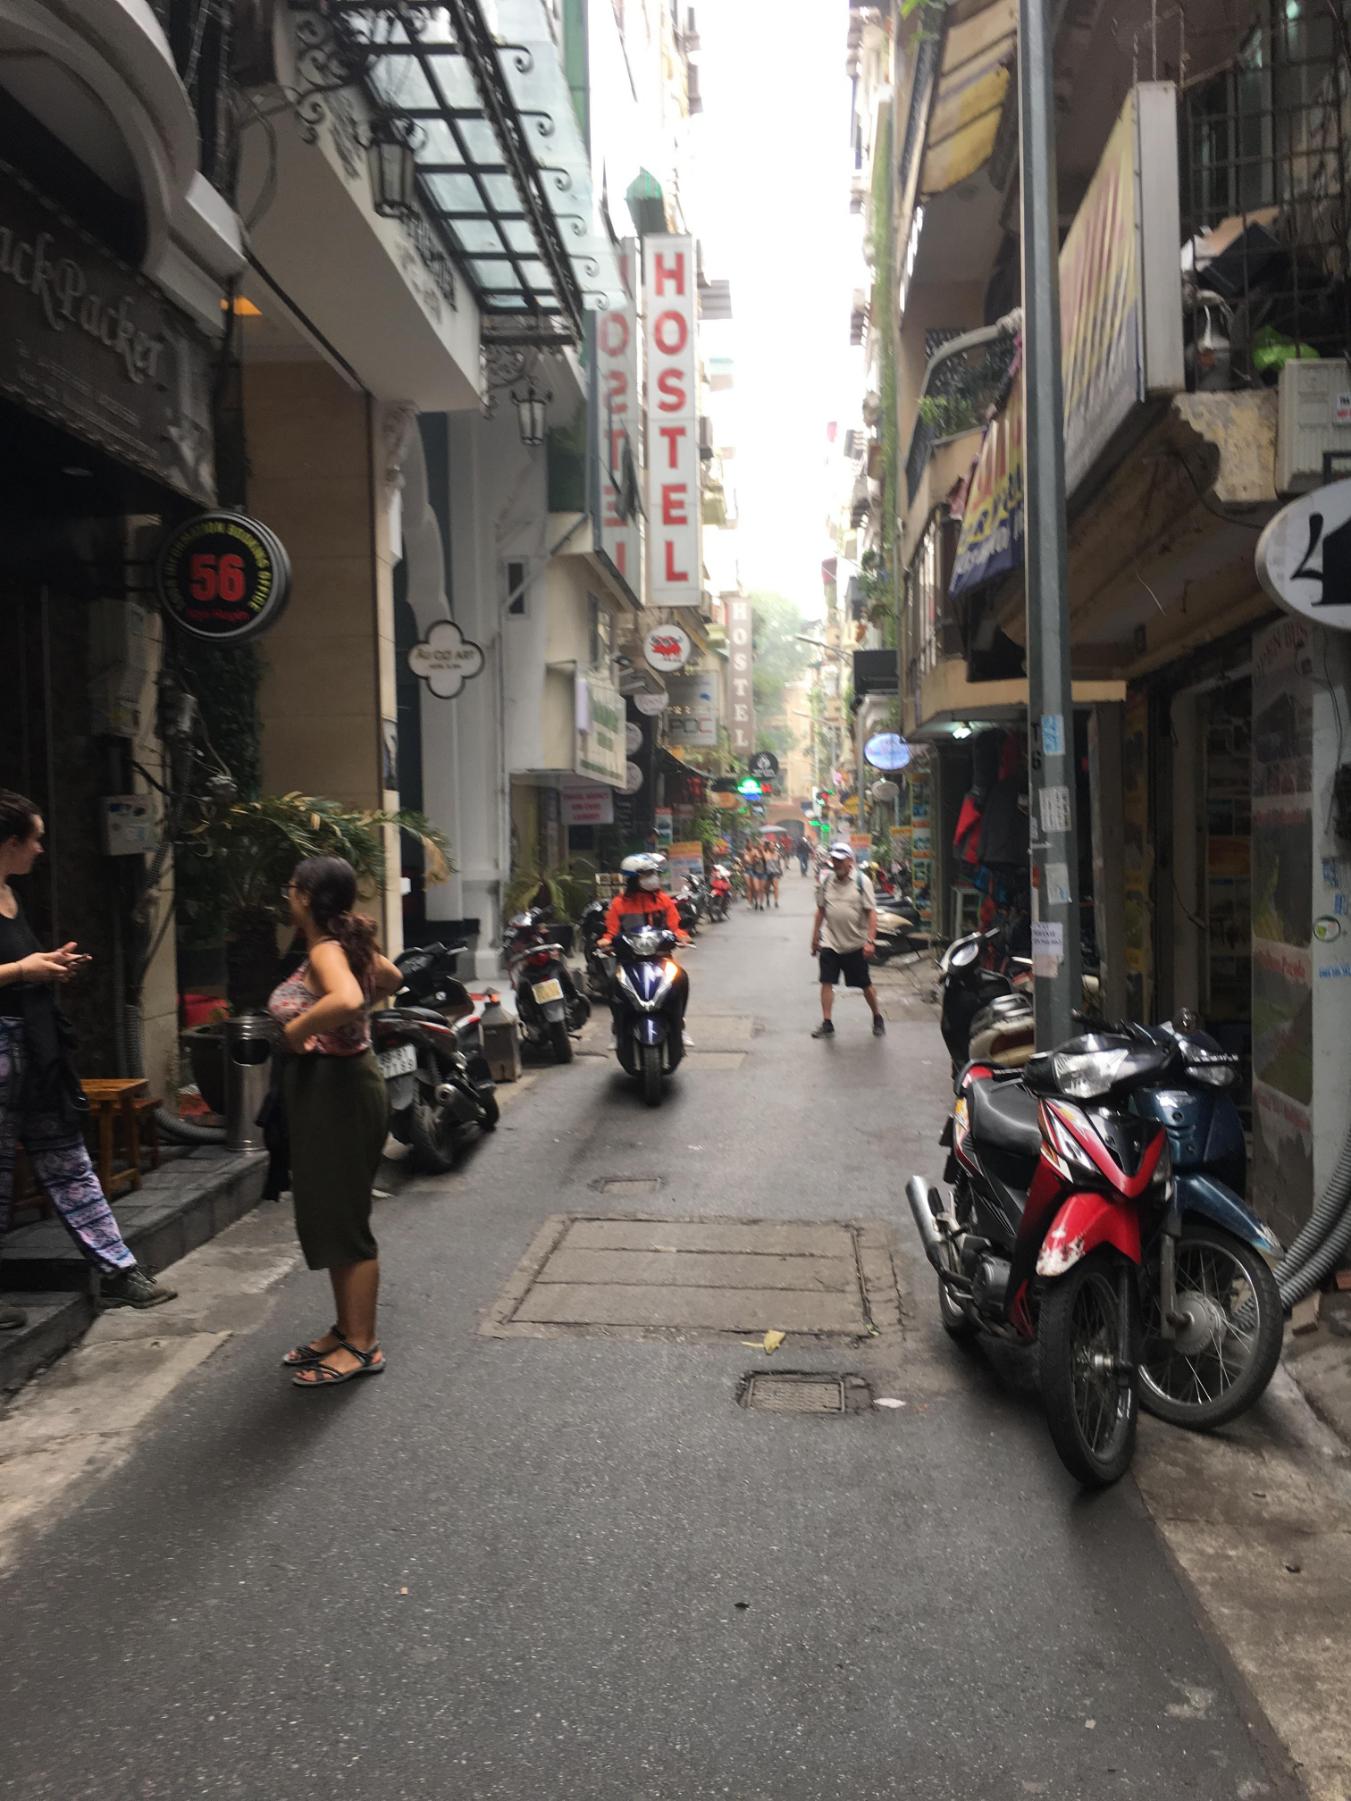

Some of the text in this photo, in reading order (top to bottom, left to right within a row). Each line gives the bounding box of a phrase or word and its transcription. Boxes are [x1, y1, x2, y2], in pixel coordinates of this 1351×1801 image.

[653, 251, 689, 583] HOSTEL
[191, 553, 244, 602] 56
[248, 568, 272, 612] OFFICE
[732, 602, 749, 747] HOSTEL
